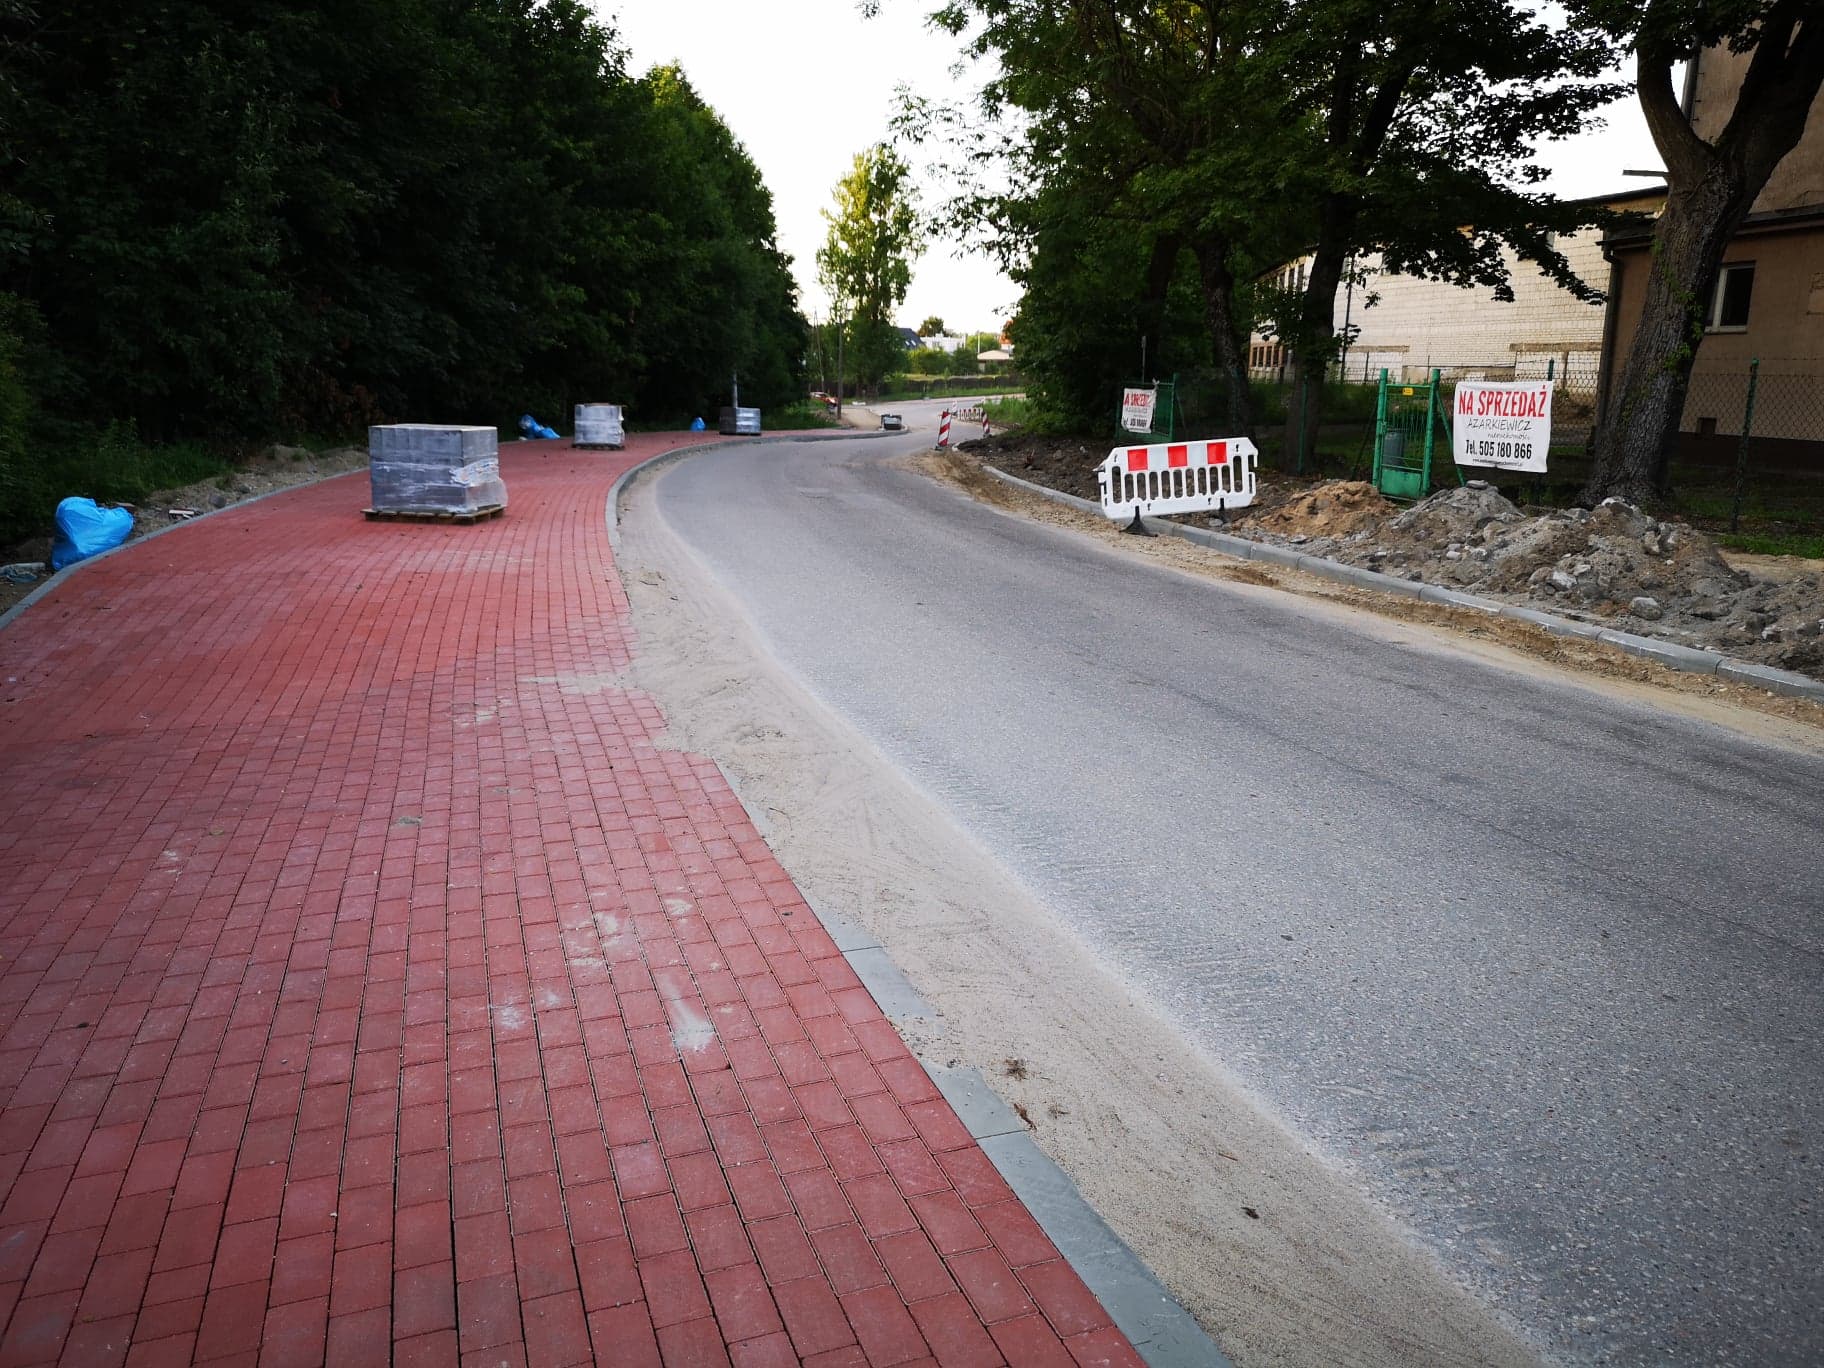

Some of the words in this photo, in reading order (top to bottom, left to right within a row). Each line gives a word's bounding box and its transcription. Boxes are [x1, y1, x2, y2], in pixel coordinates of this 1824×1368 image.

[1458, 390, 1474, 415] NA
[1477, 385, 1547, 417] SPRZEDAŻ
[1479, 441, 1495, 456] 505
[1497, 442, 1511, 458] 180
[1514, 443, 1532, 459] 866
